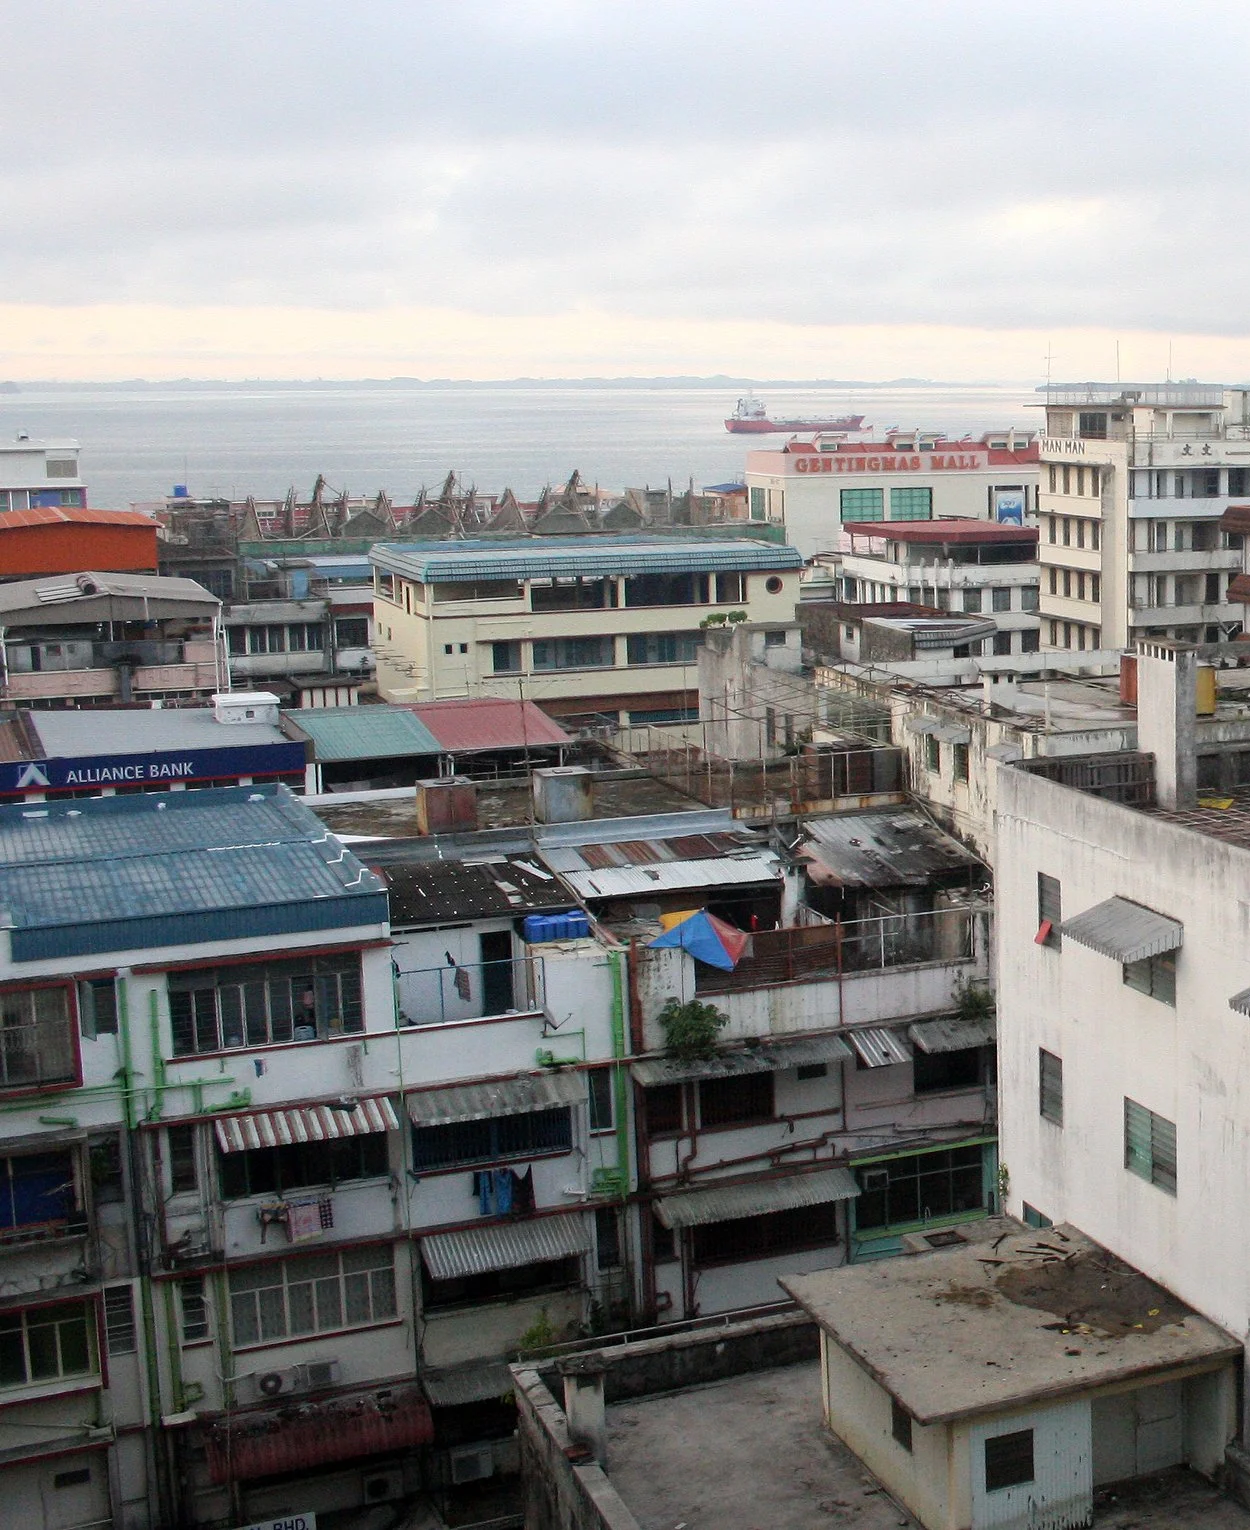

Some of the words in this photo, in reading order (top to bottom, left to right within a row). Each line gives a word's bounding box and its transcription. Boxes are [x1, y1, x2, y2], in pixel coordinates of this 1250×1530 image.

[1042, 439, 1063, 453] MAN
[1065, 441, 1085, 454] MAN
[795, 455, 920, 473] GENTINGMAS
[931, 455, 979, 470] MALL
[67, 765, 144, 784] ALLIANCE
[150, 762, 194, 778] BANK
